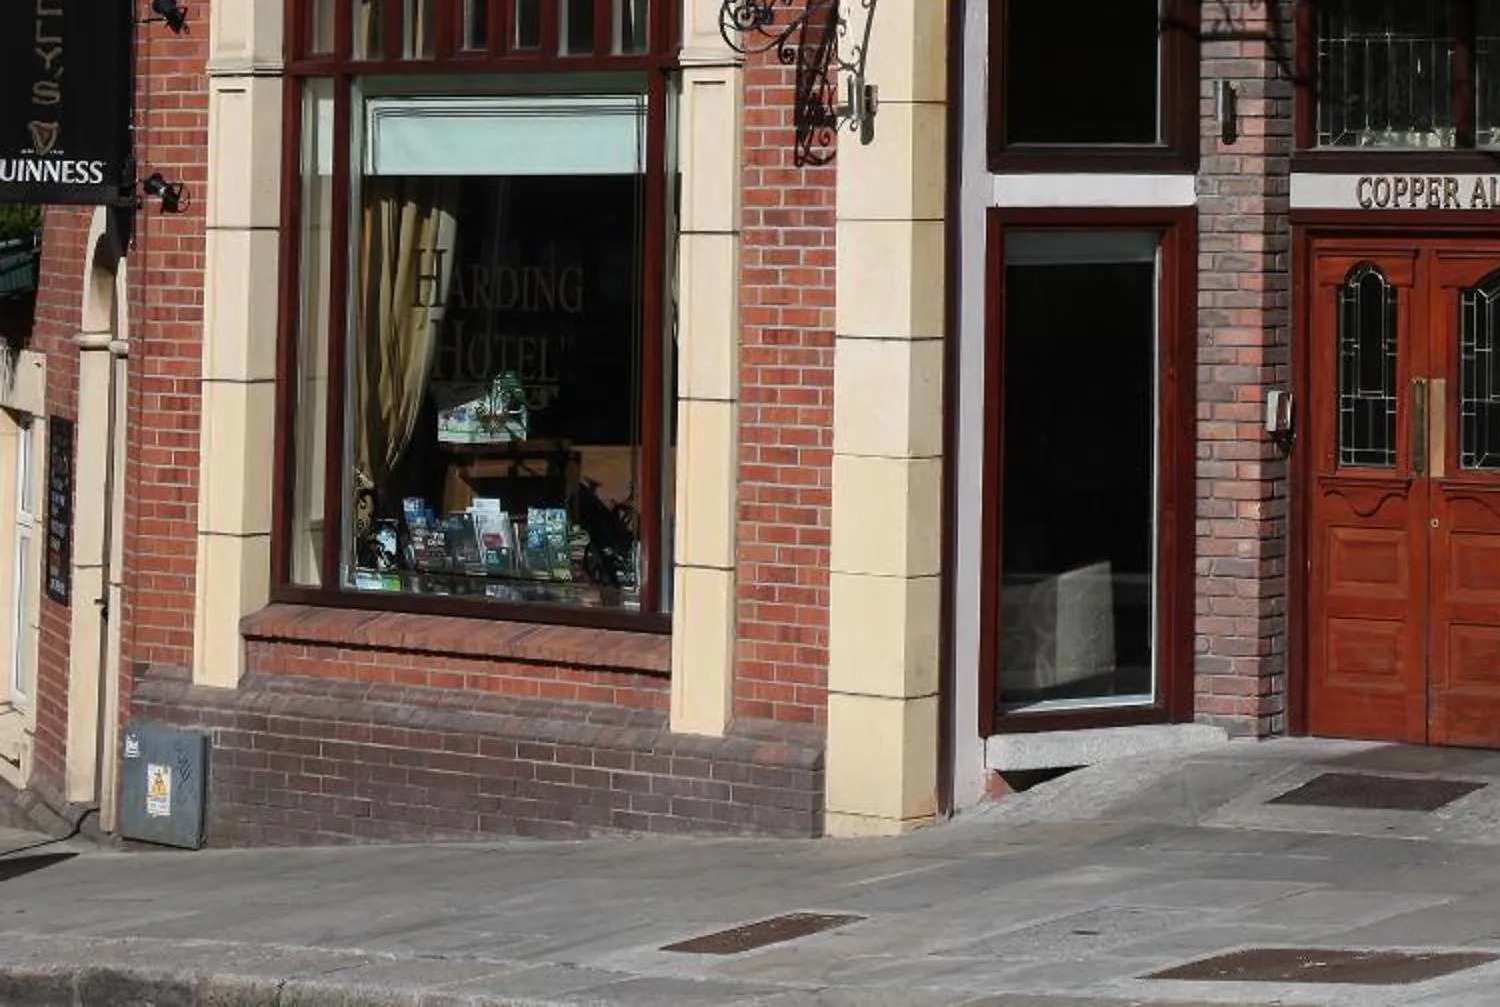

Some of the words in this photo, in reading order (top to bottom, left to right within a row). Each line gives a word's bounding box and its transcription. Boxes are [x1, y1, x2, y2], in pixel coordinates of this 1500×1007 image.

[0, 159, 104, 184] UINNESS
[1356, 176, 1460, 209] COPPER
[411, 247, 585, 314] HARDING
